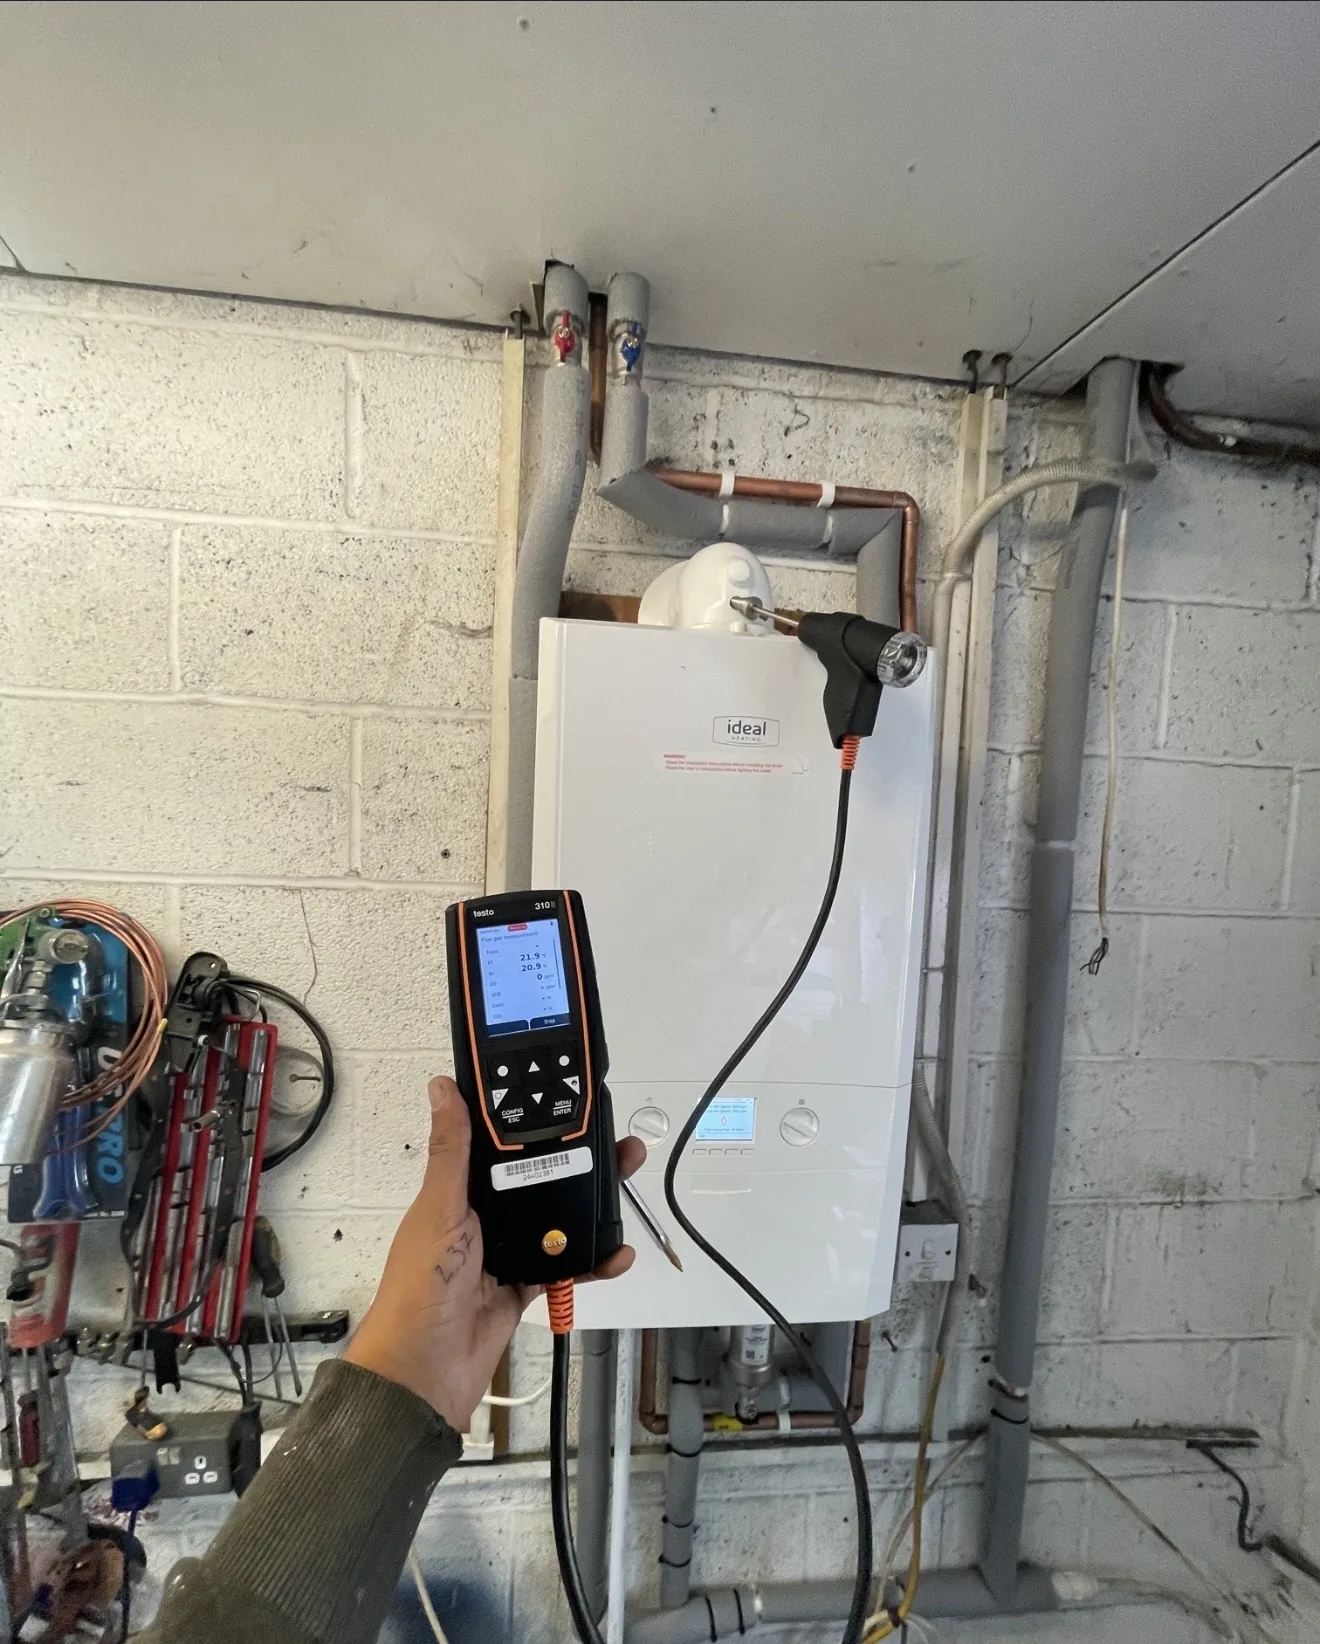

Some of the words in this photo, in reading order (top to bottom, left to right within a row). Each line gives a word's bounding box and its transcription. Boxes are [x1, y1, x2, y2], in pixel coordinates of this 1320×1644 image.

[727, 719, 767, 736] ideal
[473, 908, 495, 917] testo
[520, 952, 540, 961] 21.9
[521, 963, 541, 972] 20.9
[502, 1108, 524, 1117] CONFIG
[553, 1108, 572, 1116] ENTER
[543, 1236, 567, 1249] testo
